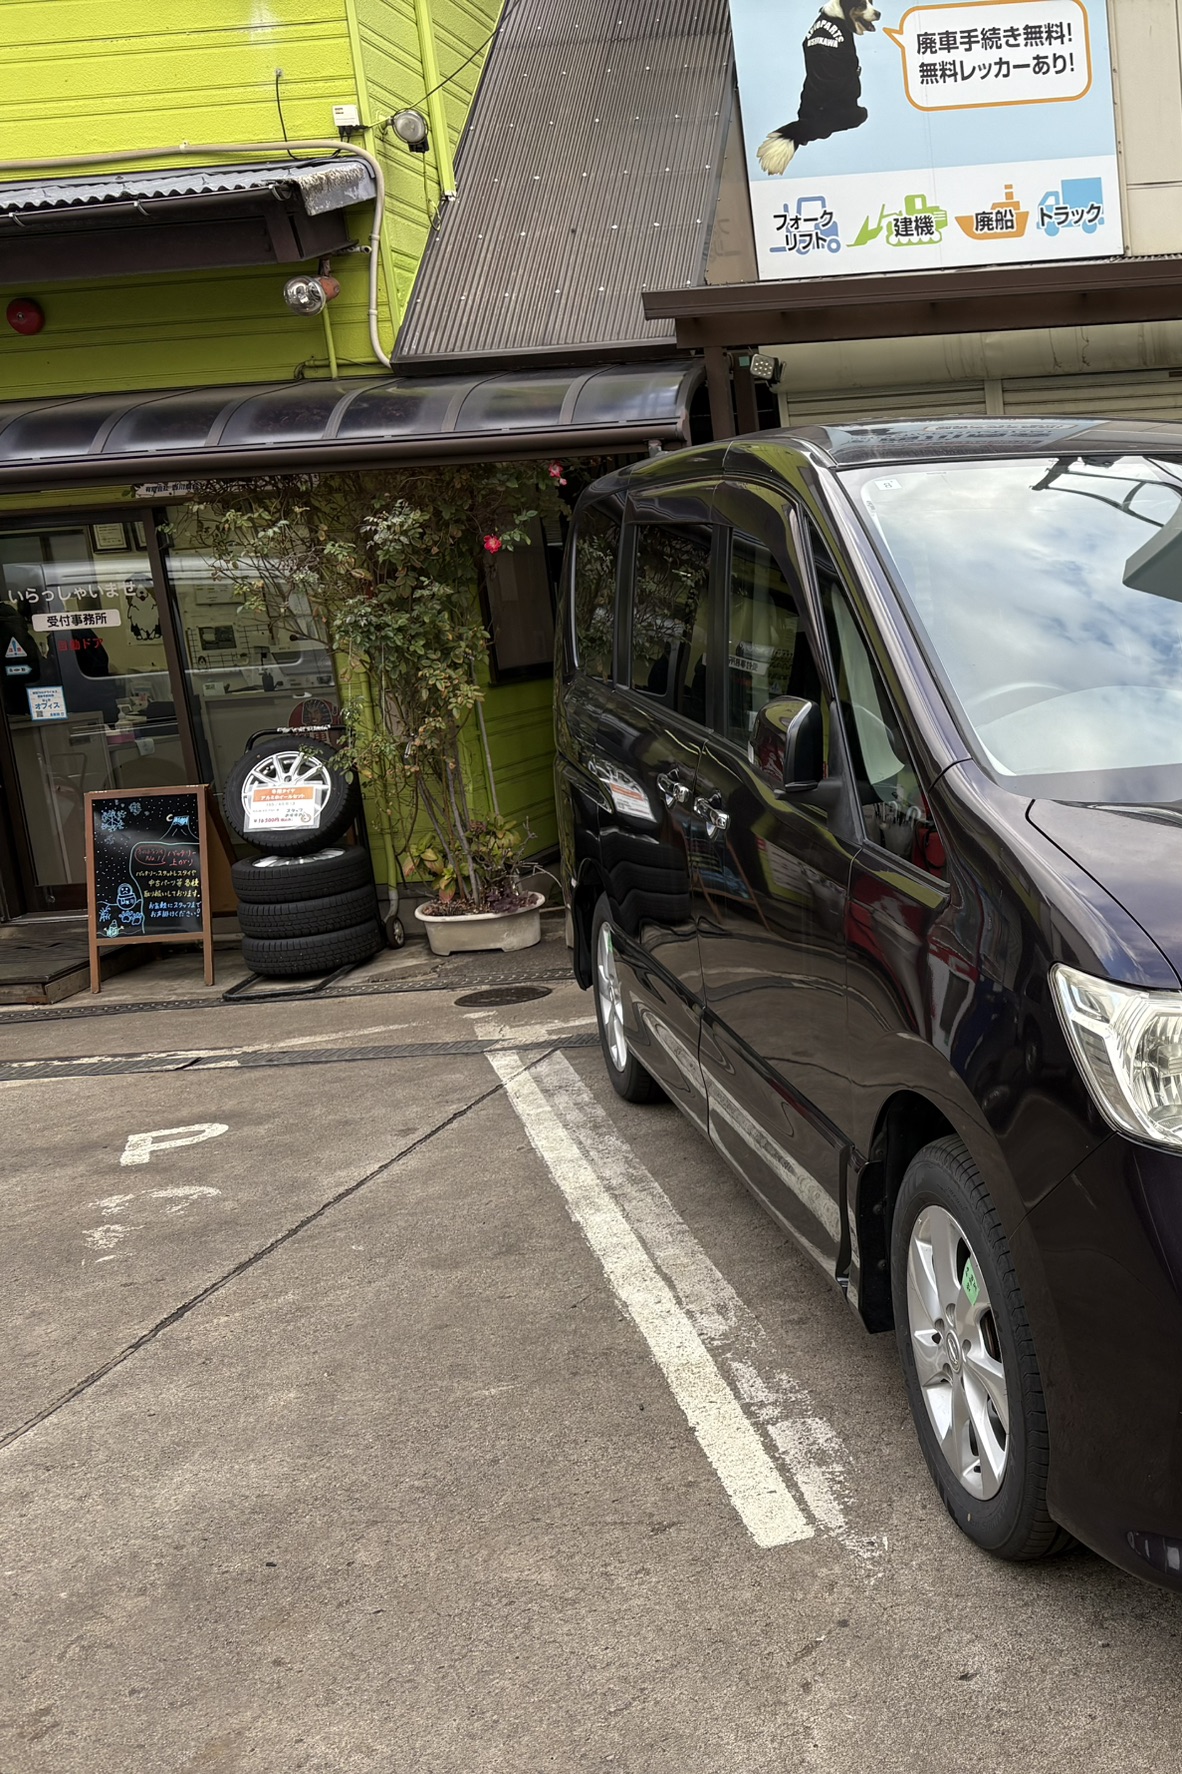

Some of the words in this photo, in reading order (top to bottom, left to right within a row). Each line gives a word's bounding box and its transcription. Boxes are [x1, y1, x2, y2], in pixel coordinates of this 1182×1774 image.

[916, 22, 1073, 55] 廃車手続き無料!
[918, 53, 1075, 86] 無料レッカーあり!
[773, 209, 835, 231] フォーク
[893, 215, 935, 237] 建機
[973, 209, 1015, 231] 廃船
[1038, 203, 1102, 227] トラック
[785, 234, 828, 251] リフト
[8, 581, 136, 604] いらっしゃいませ
[47, 612, 108, 628] 受付事務所
[58, 638, 104, 652] 自動ドア
[35, 702, 60, 710] オフィス
